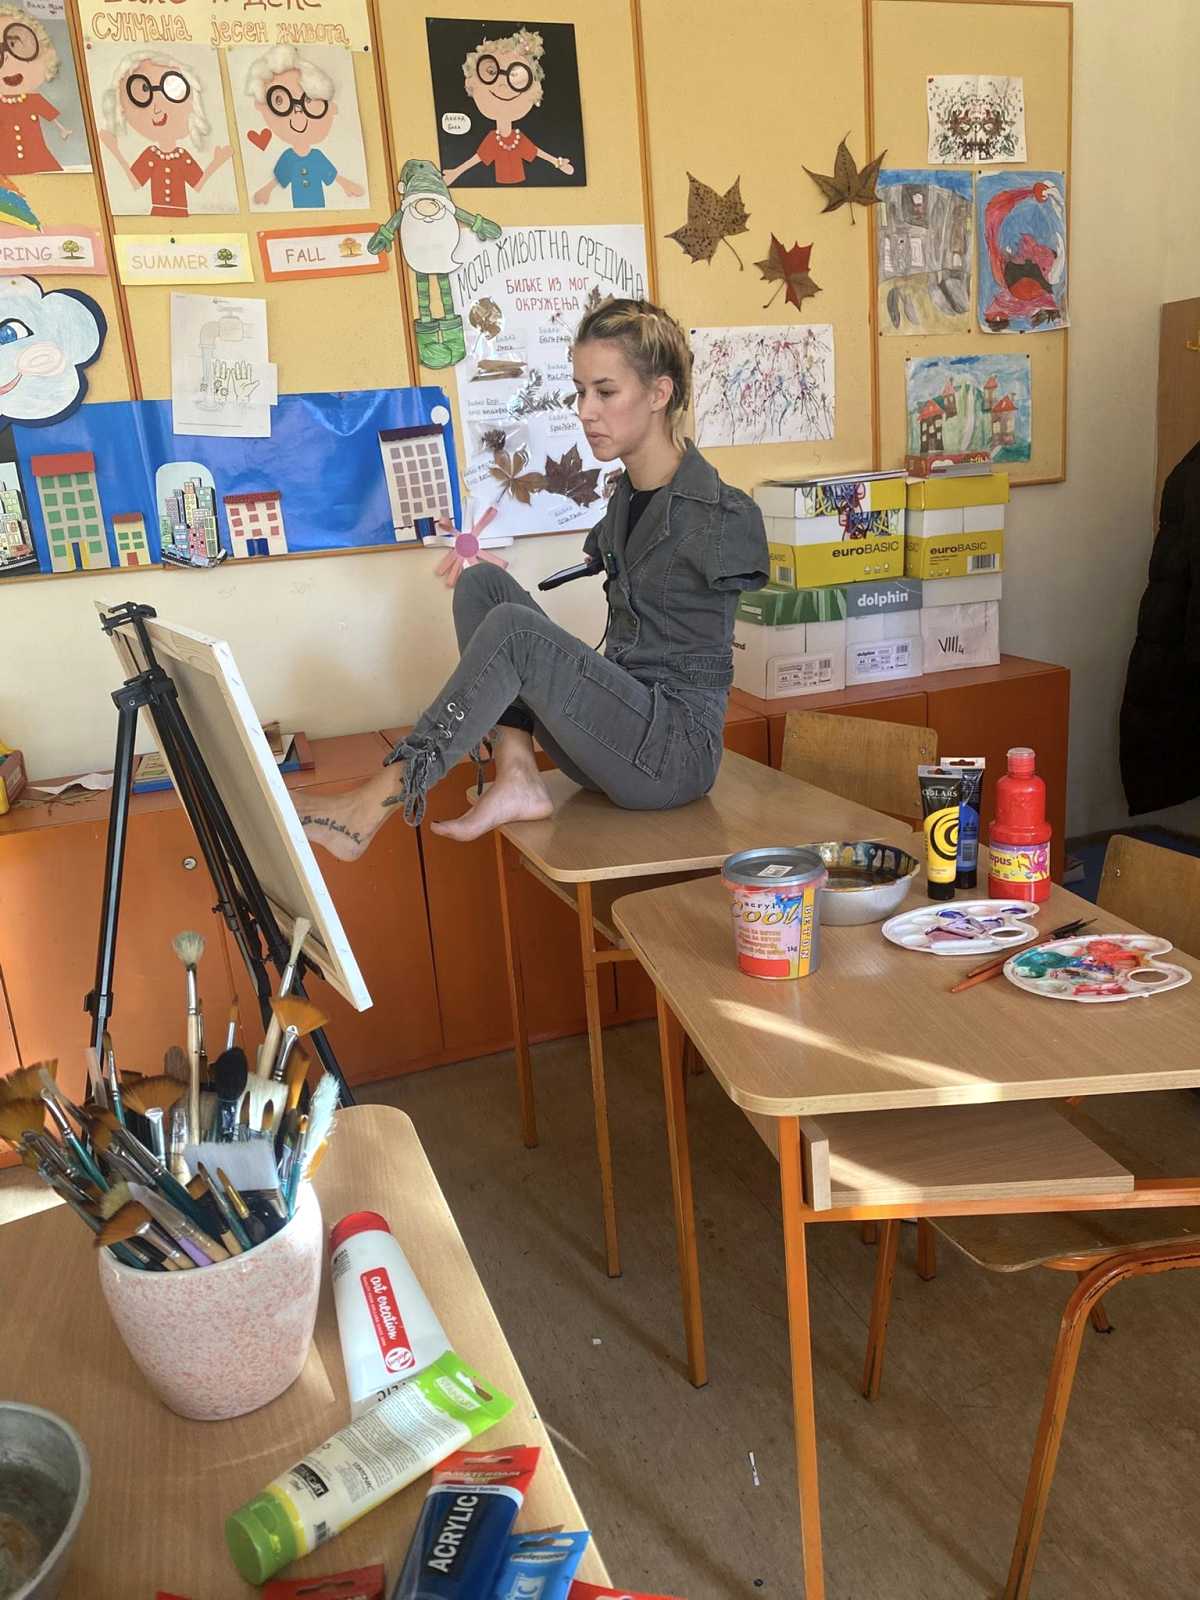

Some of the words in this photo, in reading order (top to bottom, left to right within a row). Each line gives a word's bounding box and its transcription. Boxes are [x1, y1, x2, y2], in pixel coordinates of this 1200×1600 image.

[0, 246, 52, 261] RING
[285, 248, 326, 264] FALL
[131, 254, 208, 270] SUMMER
[457, 249, 493, 307] МОЈА
[577, 235, 644, 299] СРЕДИНА
[549, 277, 562, 292] ИЗ
[568, 277, 590, 291] МОГ
[515, 296, 580, 312] ОКРУЖЕЊА
[832, 541, 899, 558] euroBASIC
[930, 542, 987, 555] euroBASIC
[857, 590, 909, 607] dolphin
[370, 1276, 387, 1294] art
[377, 1296, 398, 1340] creation
[428, 1495, 479, 1573] ACRYLIC
